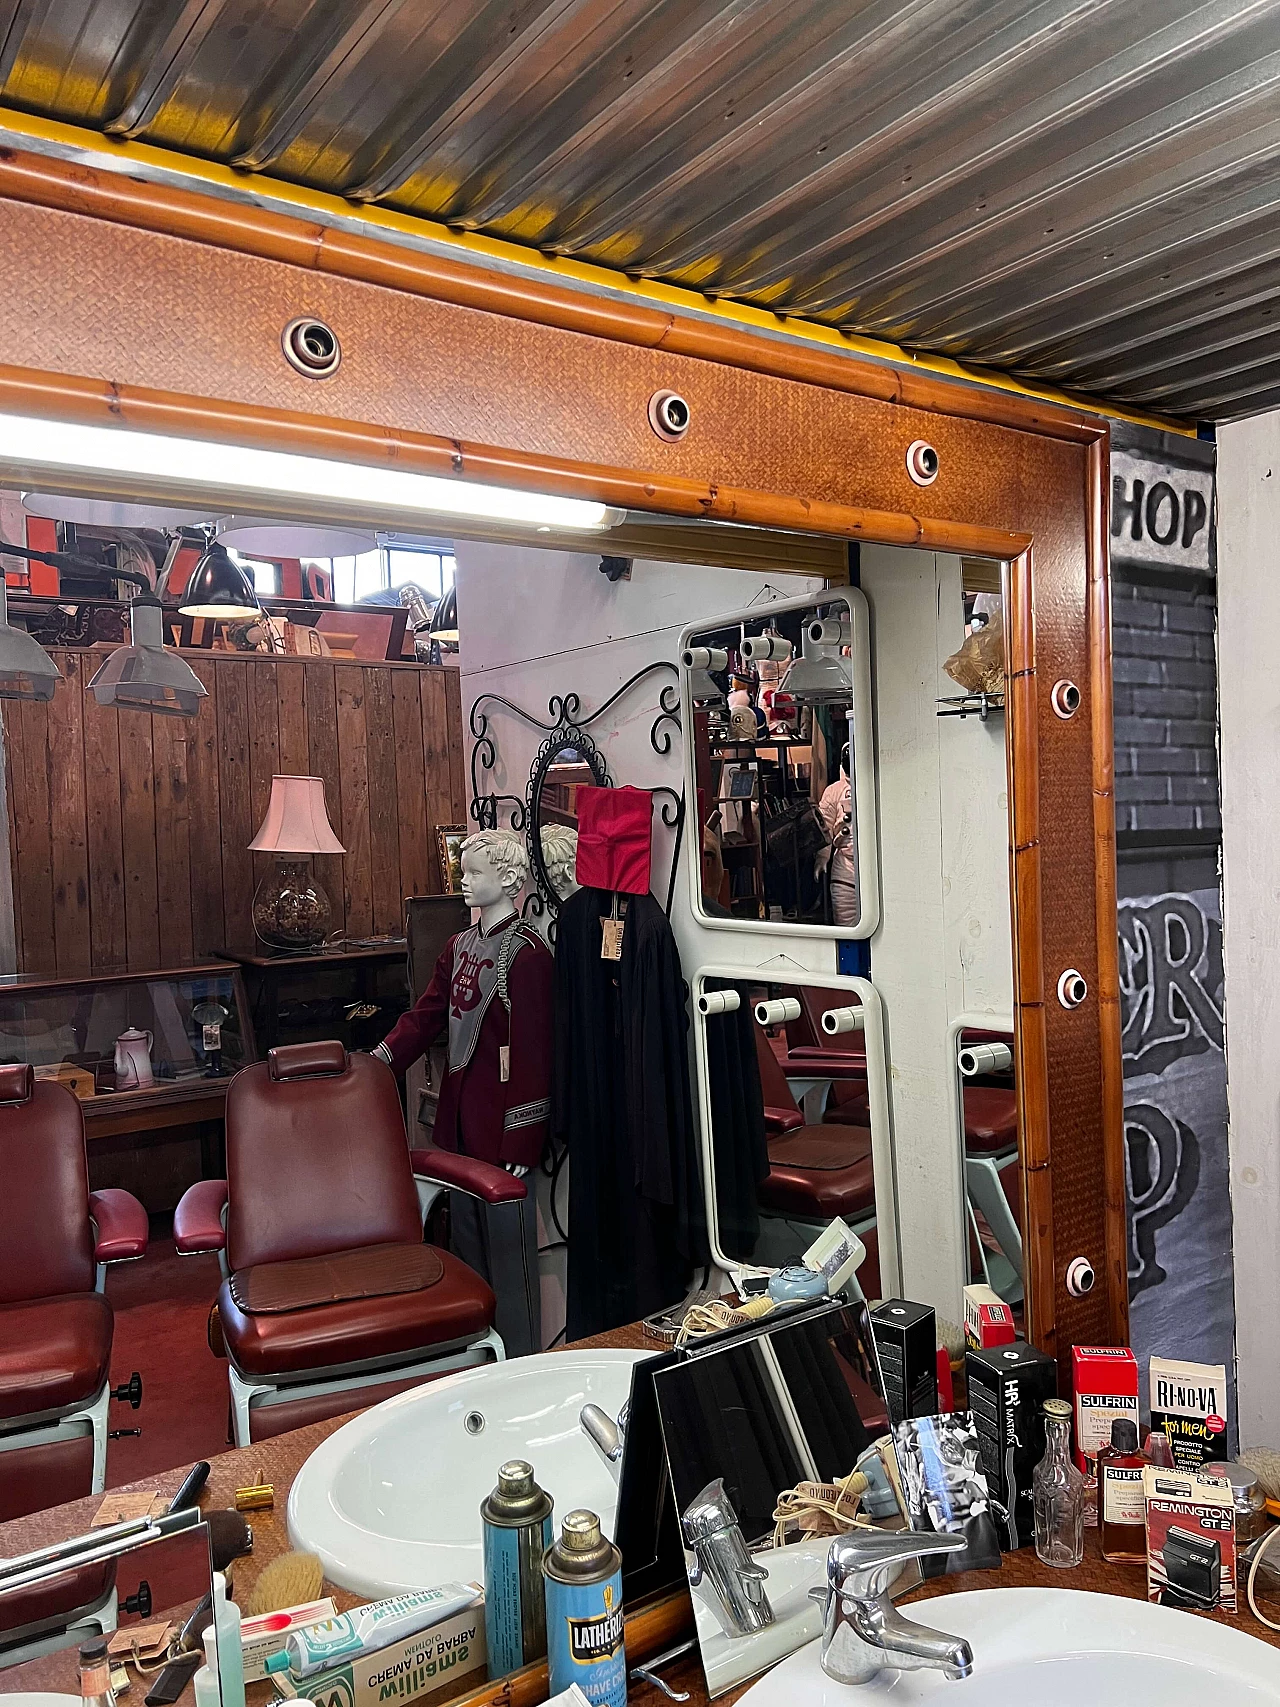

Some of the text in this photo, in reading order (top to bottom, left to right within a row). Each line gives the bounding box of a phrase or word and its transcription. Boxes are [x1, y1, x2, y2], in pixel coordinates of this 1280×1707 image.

[1111, 475, 1207, 549] HOP
[1082, 1396, 1135, 1409] SULFRIN
[1006, 1408, 1023, 1447] MATRIX
[1161, 1415, 1179, 1446] for
[1181, 1420, 1214, 1440] men
[1173, 1440, 1202, 1449] PRODOTTO
[1175, 1446, 1201, 1455] SPECIALE
[1177, 1459, 1201, 1467] CONTRO
[1150, 1500, 1232, 1521] REMINGTON
[1201, 1518, 1231, 1531] GT 2
[1189, 1553, 1208, 1564] GT 2
